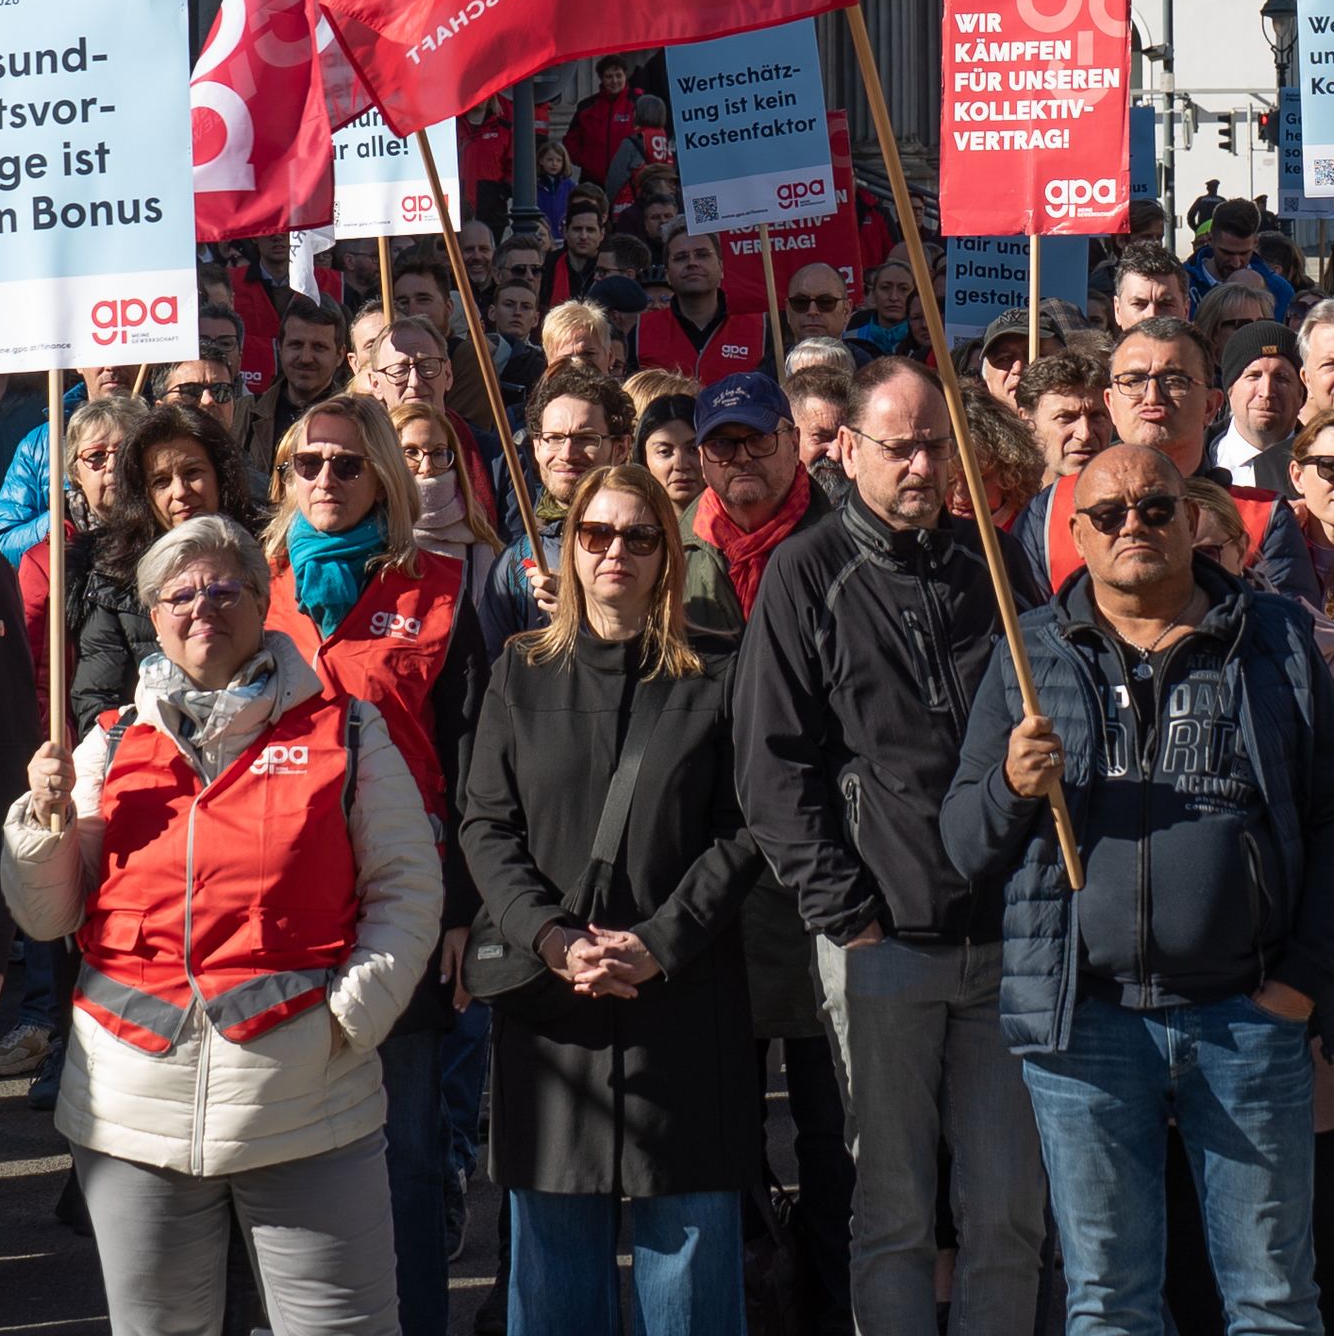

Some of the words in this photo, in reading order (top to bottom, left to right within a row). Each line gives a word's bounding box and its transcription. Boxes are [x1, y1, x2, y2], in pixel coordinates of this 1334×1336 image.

[954, 12, 1002, 33] WIR
[954, 38, 1071, 63] KÄMPFEN
[677, 64, 801, 94] Wertschätz-
[954, 68, 1002, 92] FÜR
[1009, 68, 1120, 90] UNSEREN
[682, 104, 719, 123] ung
[725, 97, 748, 115] ist
[754, 91, 797, 111] kein
[954, 99, 1094, 122] KOLLEKTIV-
[685, 117, 817, 150] Kostenfaktor
[953, 128, 1070, 151] VERTRAG!
[63, 141, 110, 176] ist
[357, 135, 409, 159] alle!
[777, 179, 825, 210] gpa
[1045, 178, 1116, 218] gpa
[32, 195, 163, 231] Bonus
[955, 236, 991, 252] fair
[955, 261, 1030, 283] planba
[955, 288, 1046, 308] gestalte
[91, 296, 178, 345] gpa
[721, 344, 749, 359] gpa
[370, 611, 421, 637] gpa
[250, 746, 308, 774] gpa
